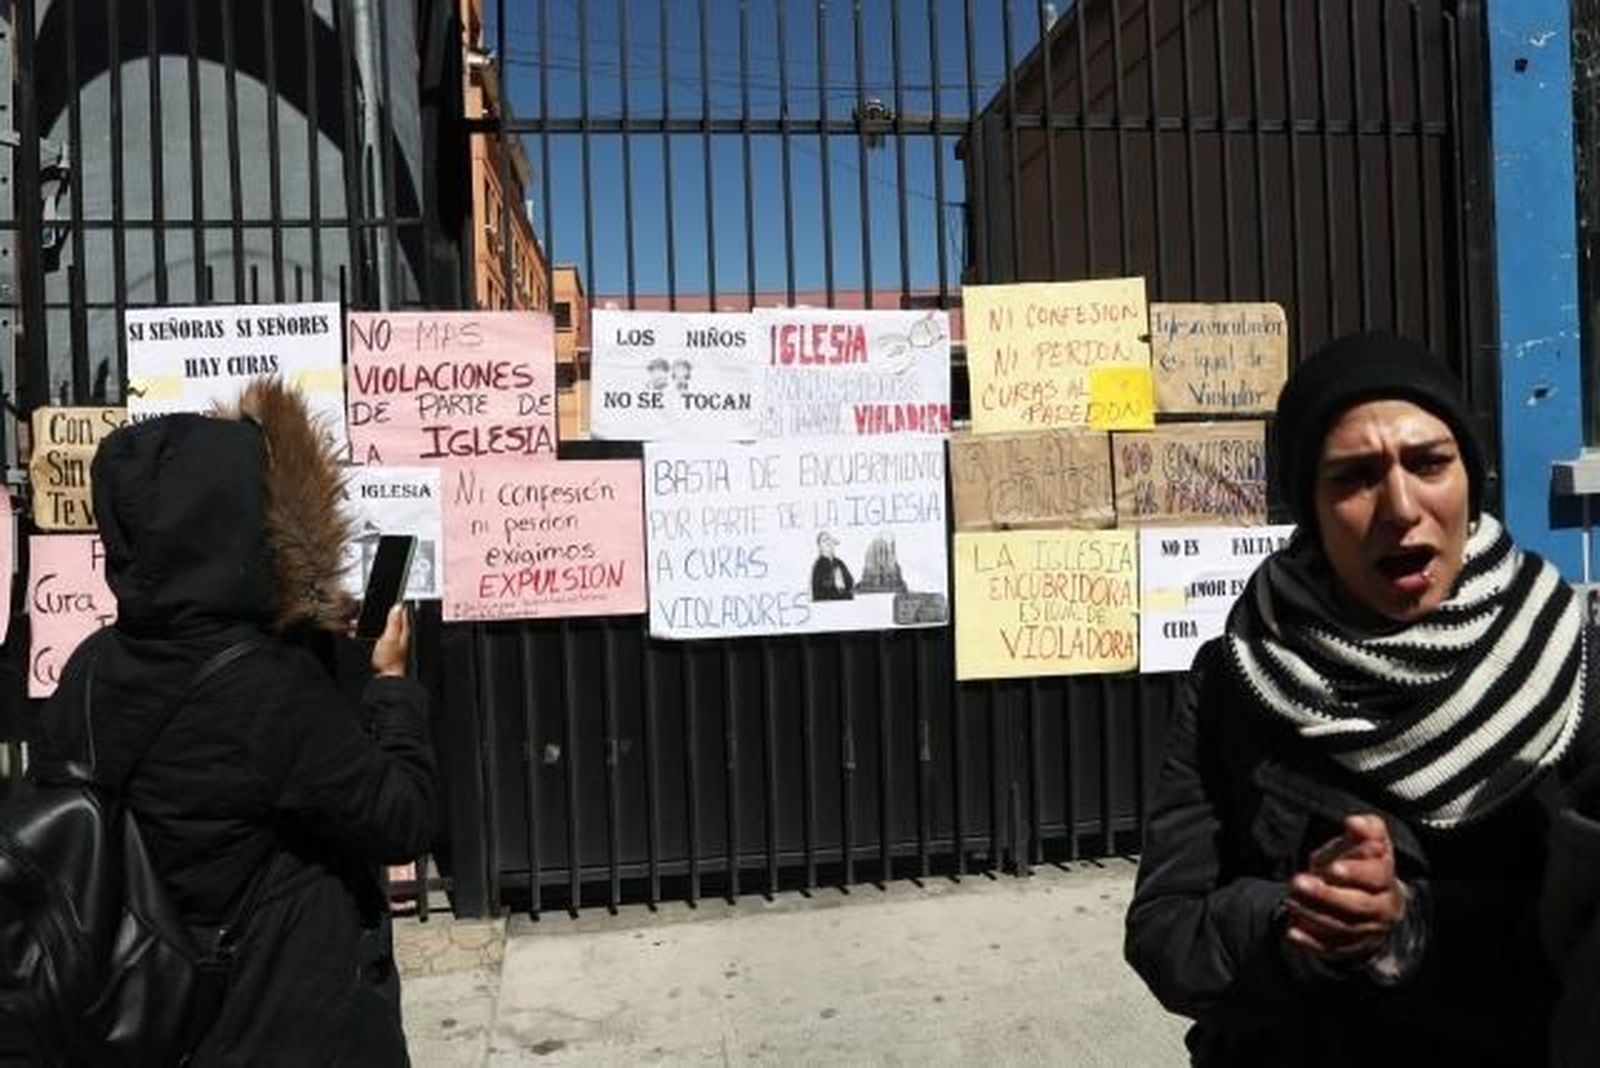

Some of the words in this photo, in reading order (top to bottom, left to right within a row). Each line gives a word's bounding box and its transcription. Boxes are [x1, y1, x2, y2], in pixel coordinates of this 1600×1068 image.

[129, 322, 144, 340] SI
[149, 317, 225, 340] SEÑORAS
[236, 320, 252, 338] SI
[257, 313, 330, 336] SEÑORES
[988, 305, 1013, 332] NI
[351, 318, 392, 354] NO
[616, 329, 655, 347] LOS
[686, 327, 747, 348] NIÑOS
[770, 323, 868, 365] IGLESIA
[185, 357, 221, 377] HAY
[227, 355, 279, 376] CURAS
[993, 344, 1018, 377] NI
[353, 361, 534, 395] VIOLACIONES
[982, 379, 1058, 411] CURAS
[351, 401, 391, 426] DE
[415, 392, 489, 420] PARTE
[517, 394, 552, 416] DE
[603, 391, 631, 409] NO
[637, 391, 664, 409] SE
[682, 393, 752, 411] TOCAN
[50, 410, 94, 446] Con
[349, 441, 383, 467] LA
[419, 423, 553, 459] IGLESIA
[48, 450, 84, 488] Sin
[654, 457, 730, 496] BASTA
[749, 454, 780, 490] DE
[361, 484, 431, 499] IGLESIA
[454, 468, 484, 506] Ni
[650, 506, 694, 543] POR
[845, 491, 941, 527] IGLESIA
[486, 542, 596, 572] exigimos
[974, 543, 1016, 573] LA
[1232, 537, 1274, 556] FALTA
[479, 560, 625, 599] EXPULSION
[656, 549, 673, 582] A
[684, 546, 769, 581] CURAS
[33, 574, 97, 614] Cura
[989, 573, 1133, 607] ENCUBRIDORA
[658, 592, 814, 630] VIOLADORES
[1000, 625, 1134, 660] VIOLADORA
